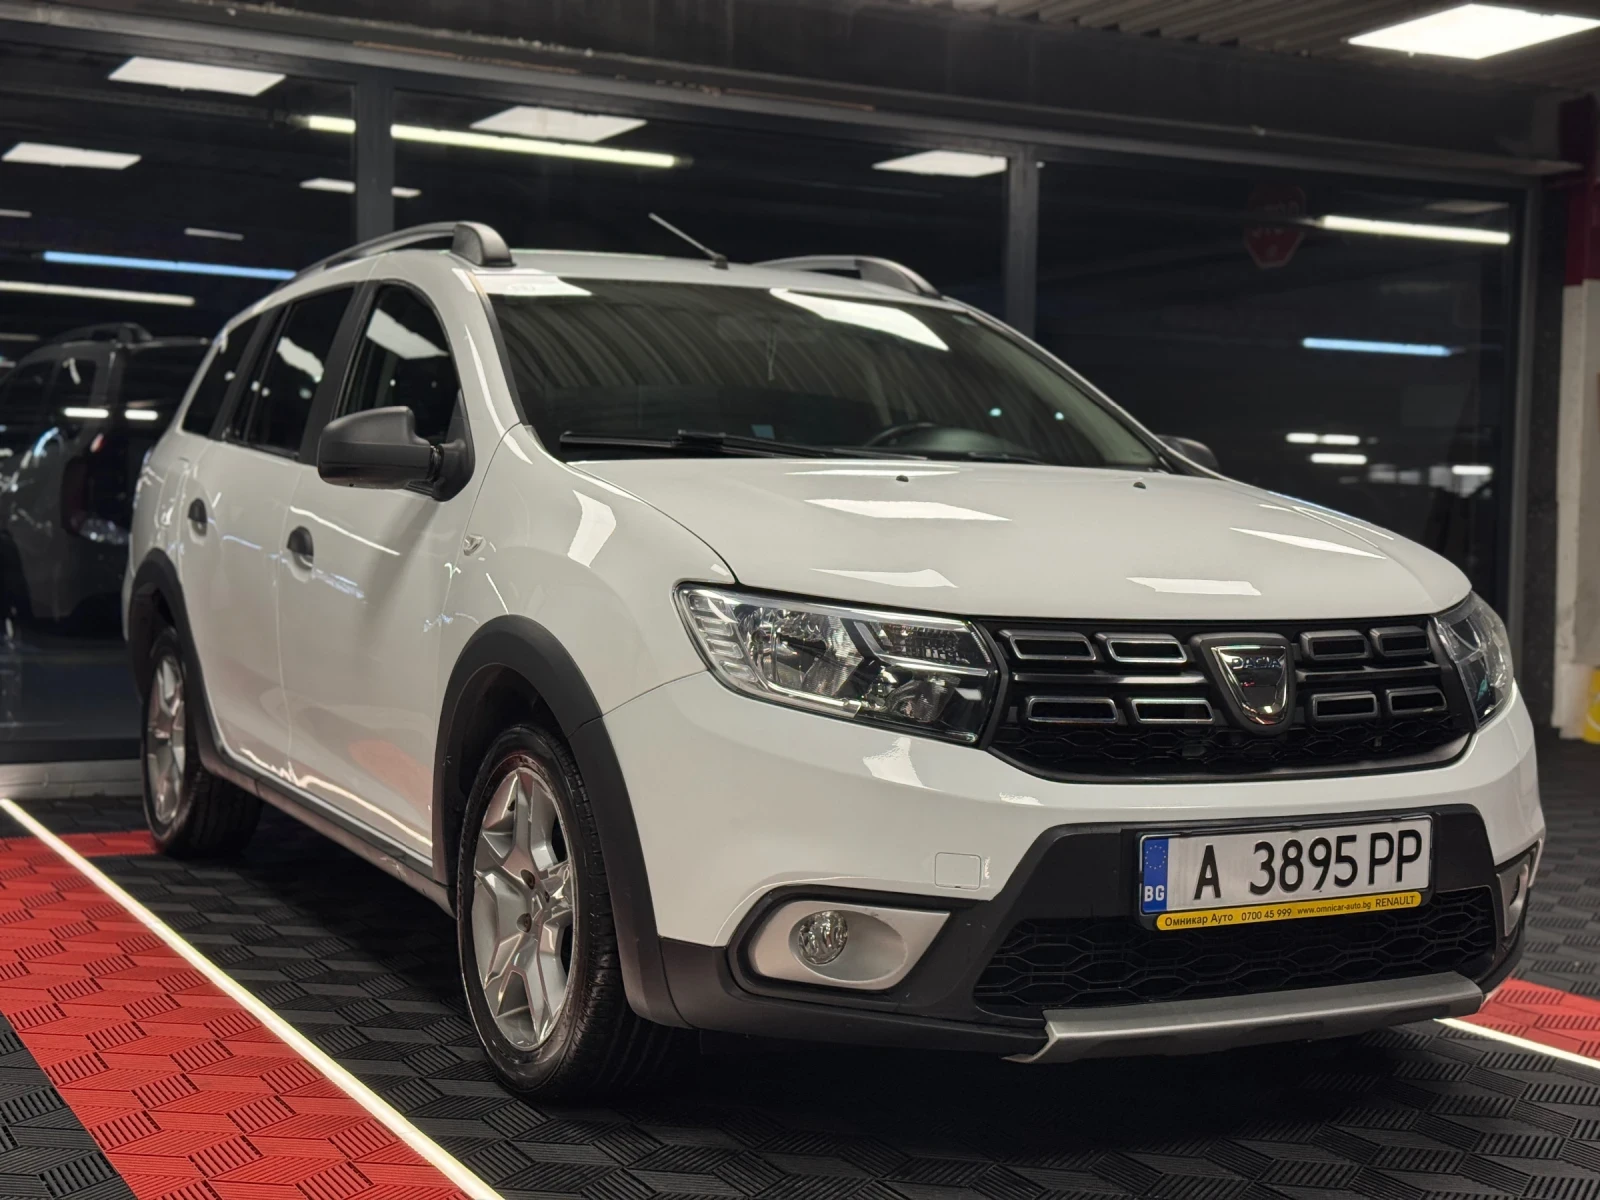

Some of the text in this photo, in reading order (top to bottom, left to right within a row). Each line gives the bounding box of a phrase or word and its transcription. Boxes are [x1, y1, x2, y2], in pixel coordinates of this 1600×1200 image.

[1232, 656, 1282, 670] DACIA
[1194, 844, 1221, 900] A
[1144, 885, 1165, 902] BG
[1165, 895, 1416, 927] Омникар Ауто 0700 45 999 www.omnicar-auto.bg RENAULT
